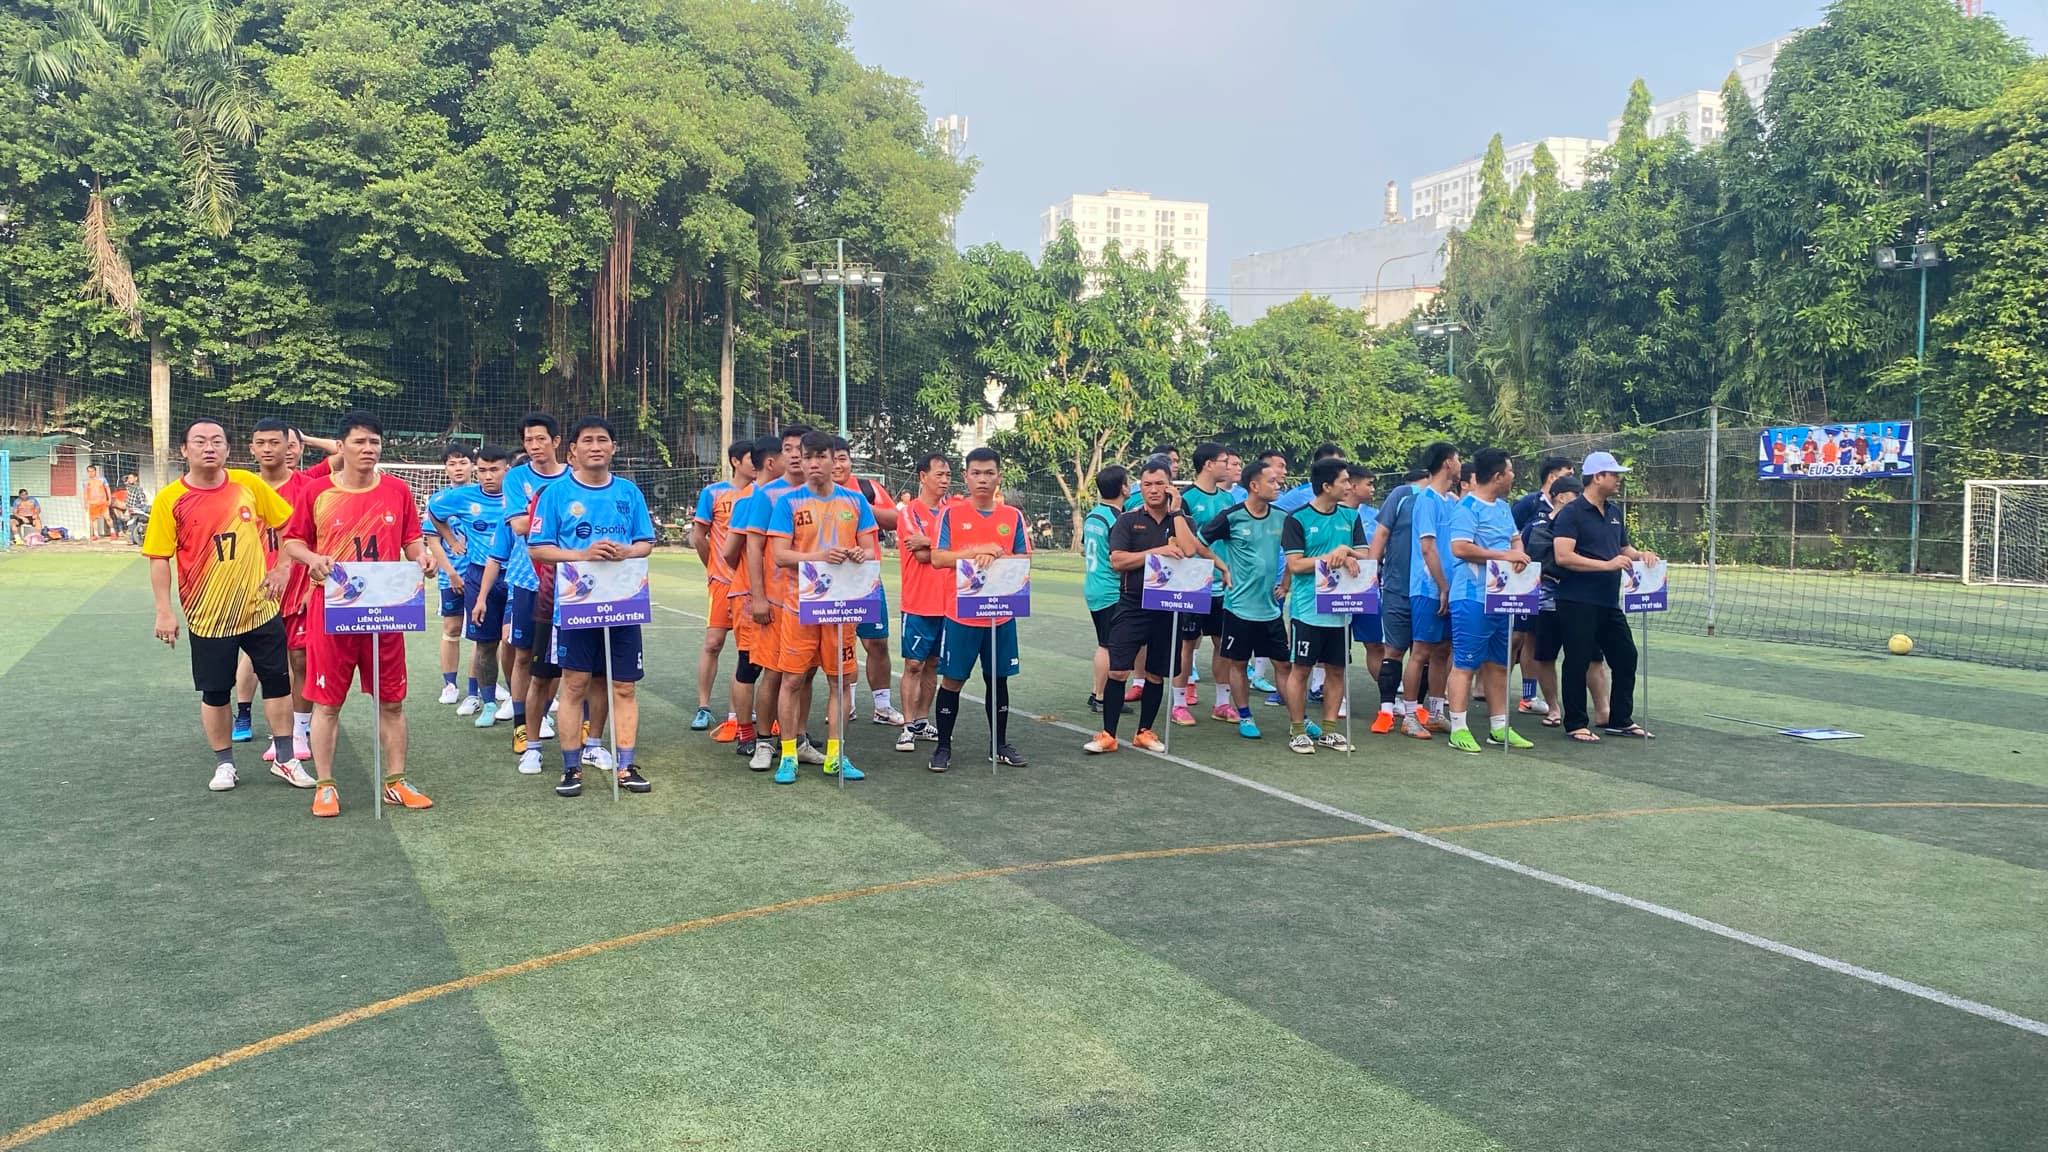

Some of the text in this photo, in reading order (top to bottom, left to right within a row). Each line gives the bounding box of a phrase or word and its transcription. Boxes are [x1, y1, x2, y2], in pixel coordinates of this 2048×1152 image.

[722, 501, 732, 513] 17
[796, 510, 813, 526] 33
[213, 532, 237, 562] 17
[354, 535, 379, 562] 14
[368, 607, 382, 615] ĐỘI
[596, 603, 613, 614] ĐỘI
[841, 608, 853, 616] LỌC
[357, 615, 373, 623] LIÊN
[567, 612, 645, 625] CÔNG TY SUỐI TIÊN
[335, 624, 350, 632] CỦA
[382, 623, 406, 631] THÀNH
[911, 635, 922, 651] 7
[1226, 635, 1235, 650] 7
[1297, 640, 1310, 657] 13
